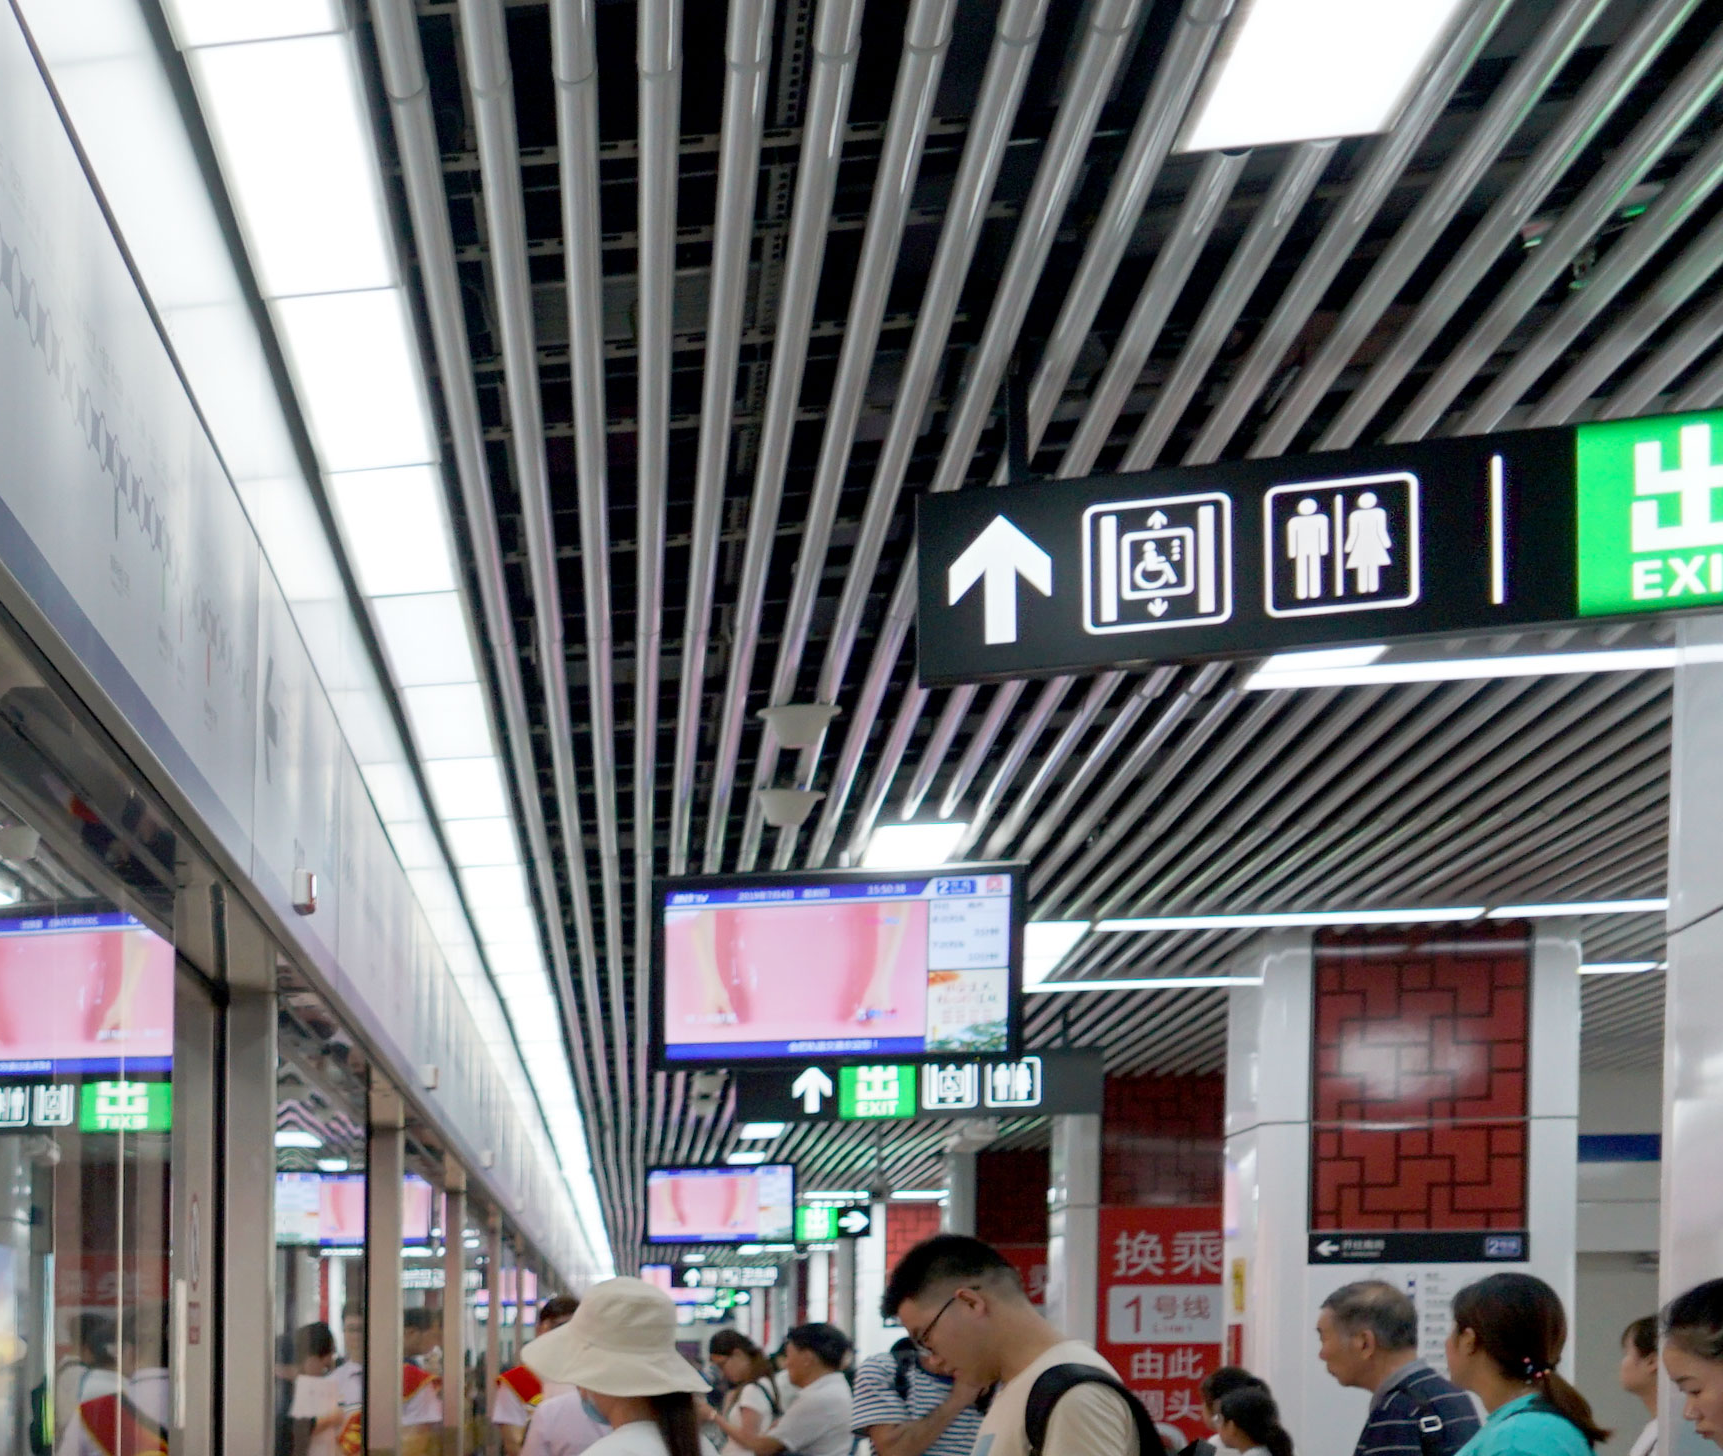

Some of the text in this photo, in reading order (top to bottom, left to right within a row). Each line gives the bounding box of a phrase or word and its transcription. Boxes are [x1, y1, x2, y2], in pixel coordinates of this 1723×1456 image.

[1632, 553, 1723, 601] EXI
[855, 1100, 899, 1117] EXIT
[1112, 1229, 1223, 1277] 换乘
[1130, 1347, 1204, 1380] 由此
